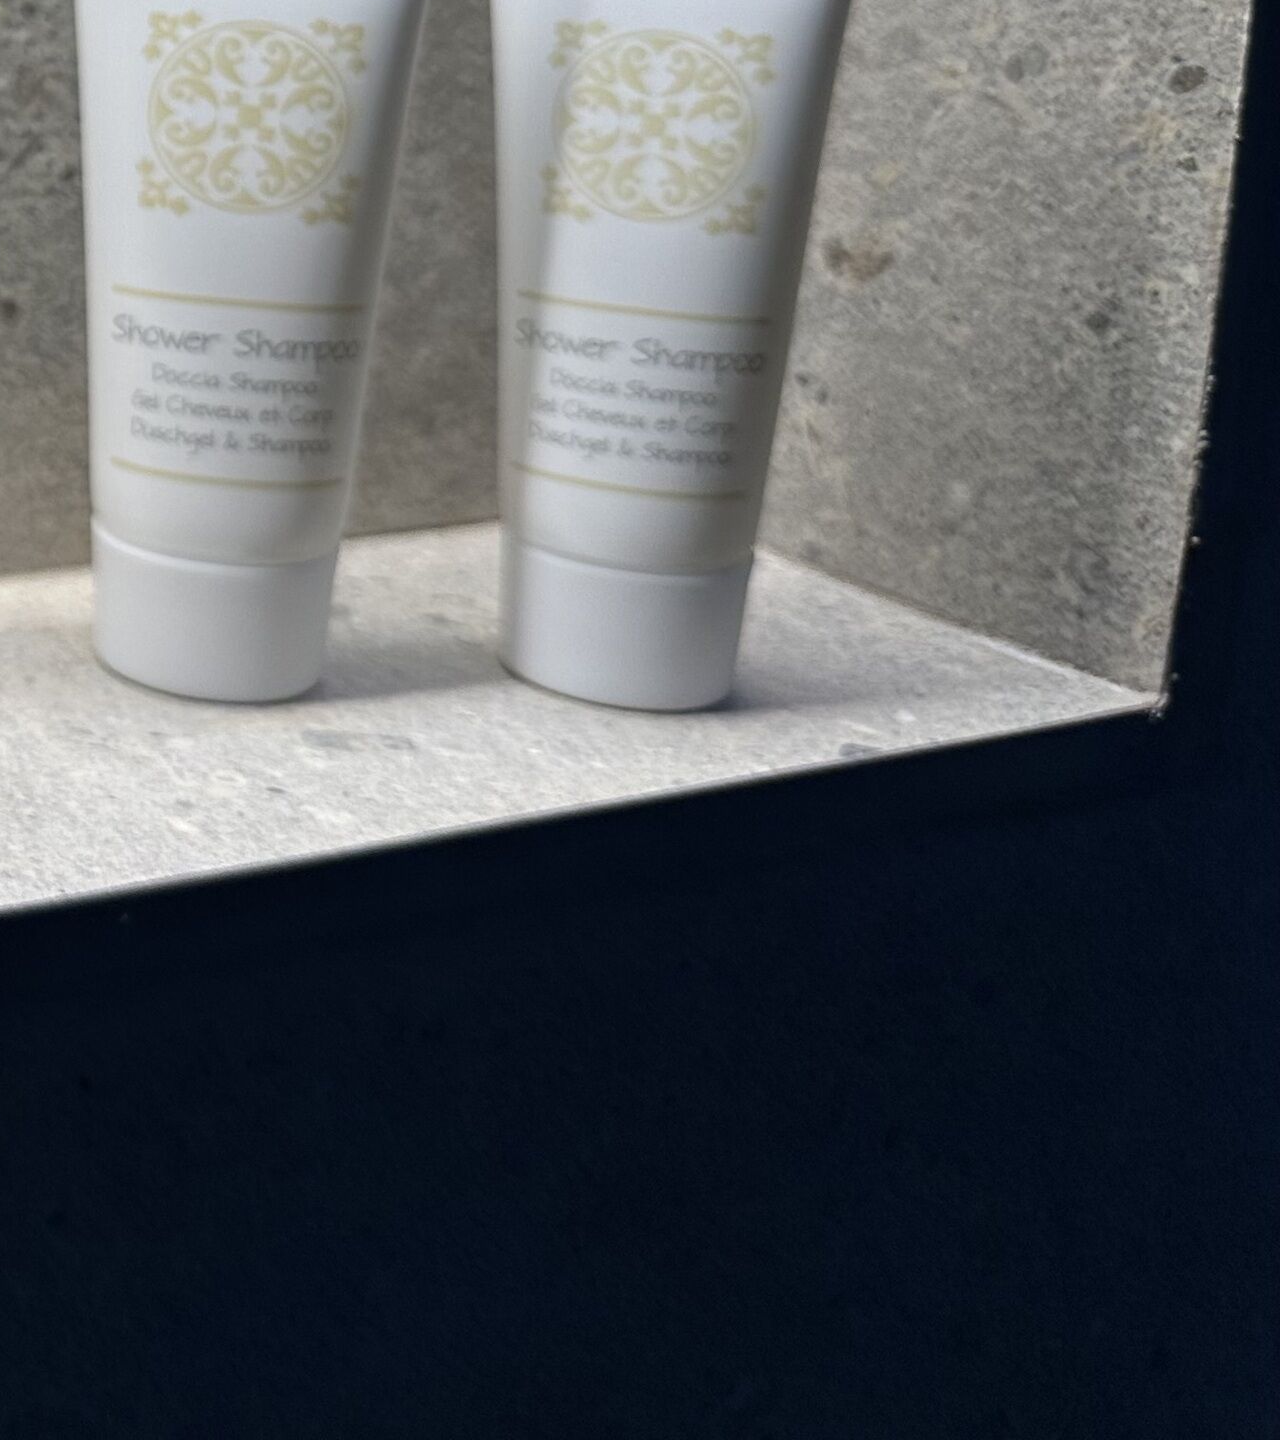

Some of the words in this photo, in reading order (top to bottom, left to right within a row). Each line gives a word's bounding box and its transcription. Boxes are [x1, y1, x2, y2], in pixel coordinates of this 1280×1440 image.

[111, 312, 221, 353] Shower
[233, 329, 360, 374] Shampoo
[515, 317, 621, 360] Shower
[630, 337, 768, 384] Shampoo
[151, 361, 220, 389] Doccia
[229, 371, 318, 403] Shampoo
[624, 378, 718, 411] Shampoo
